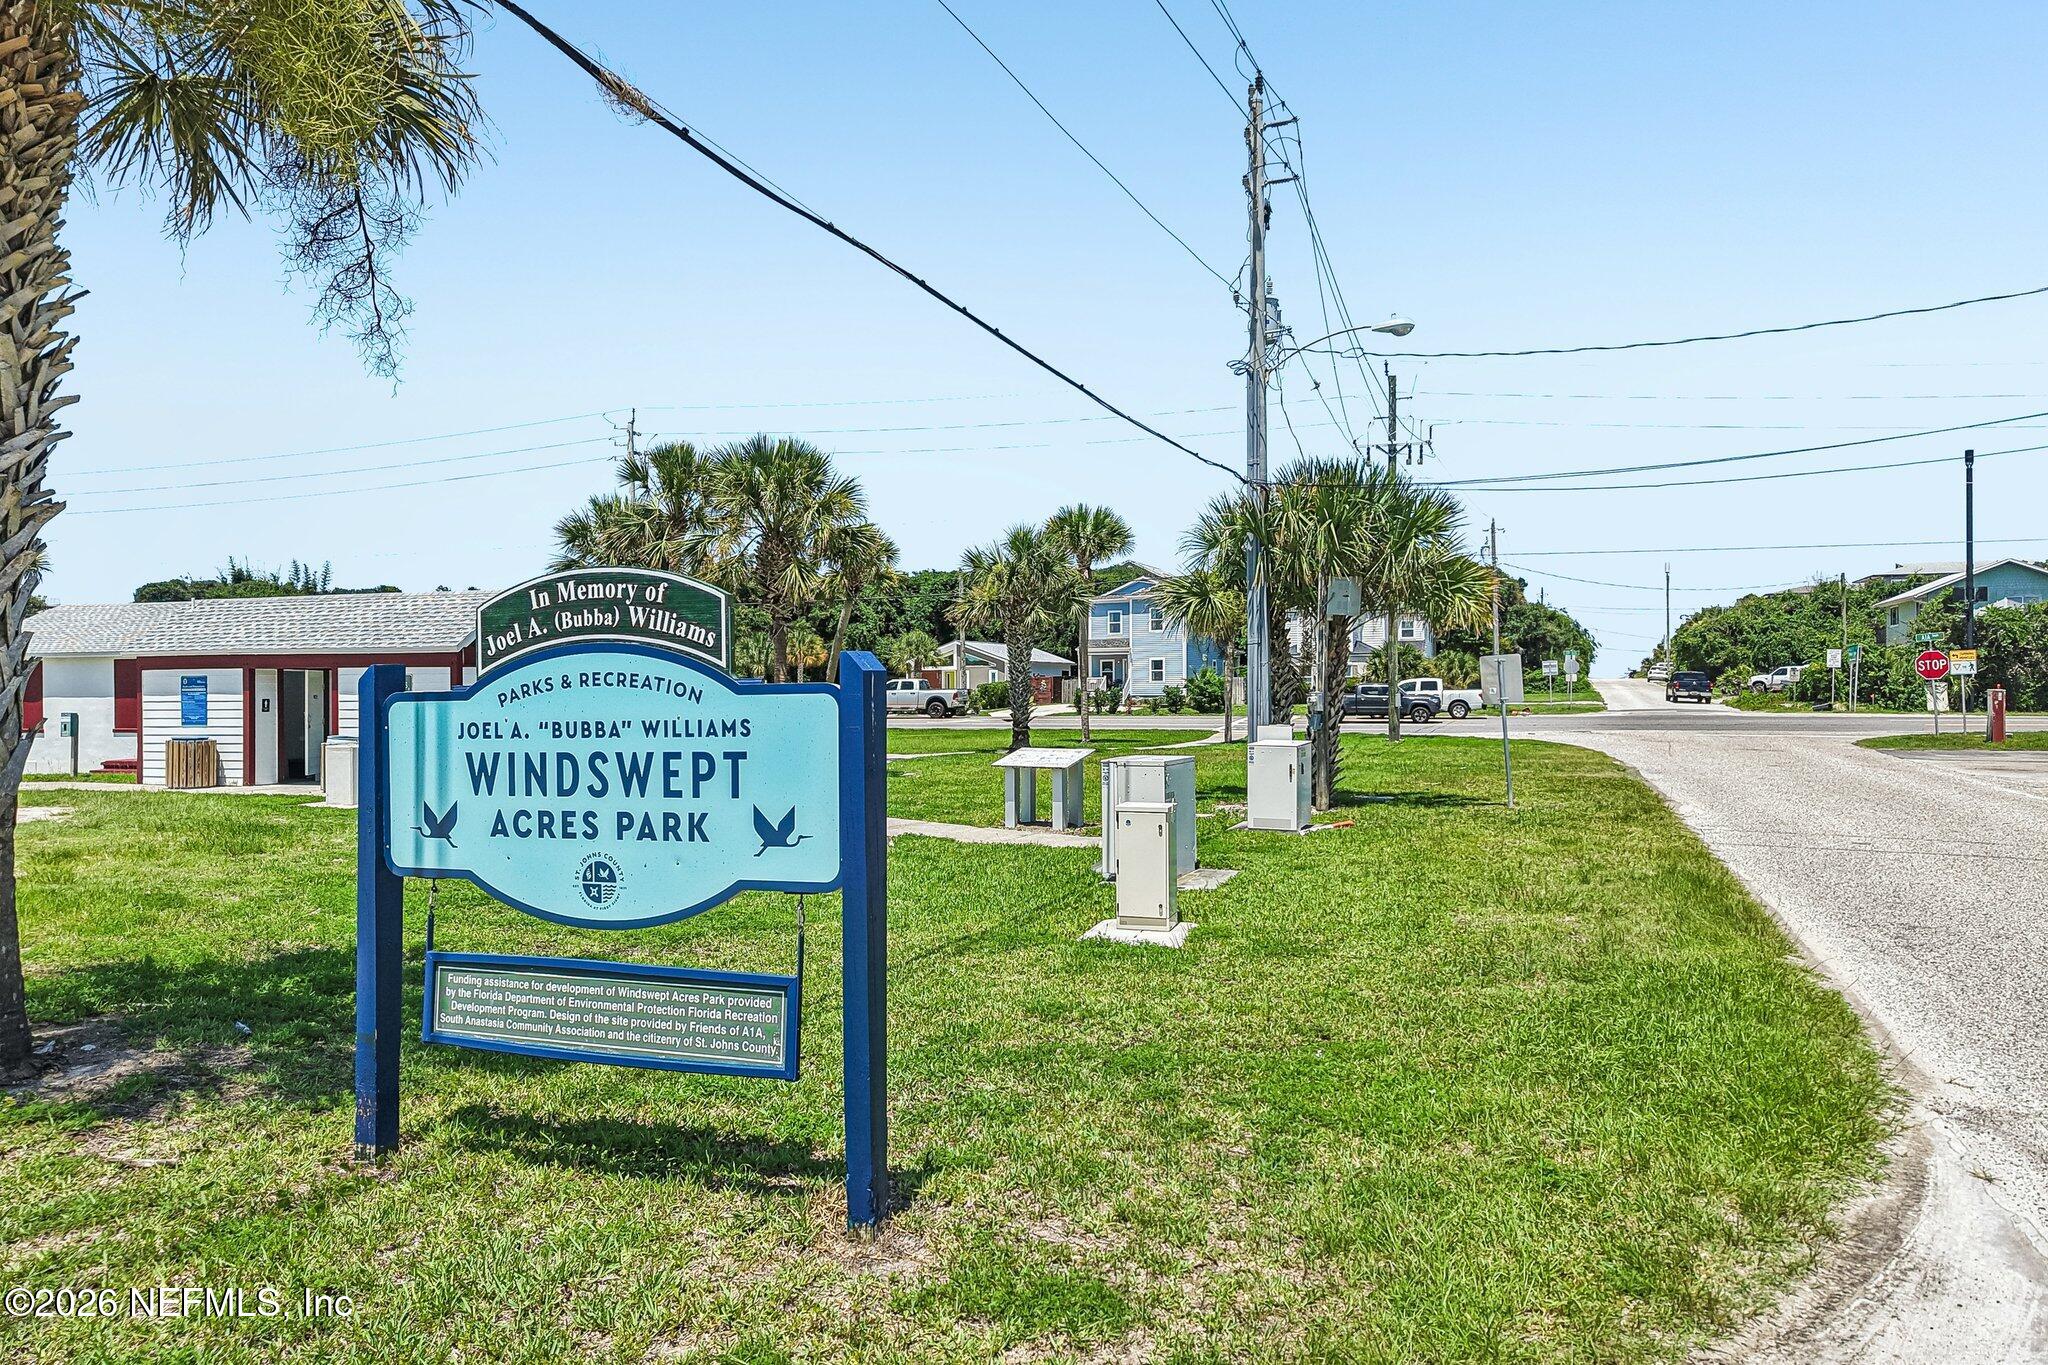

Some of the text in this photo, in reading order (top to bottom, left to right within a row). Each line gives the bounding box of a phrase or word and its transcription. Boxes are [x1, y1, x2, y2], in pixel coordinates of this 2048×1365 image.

[528, 580, 669, 611] In Memory of
[485, 605, 717, 657] Joel A. (Bubba) Williams
[1918, 659, 1947, 671] STOP
[498, 672, 703, 707] PARKS & RECREATION
[458, 718, 751, 739] JOEL A. "BUBBA" WILLIAMS
[465, 751, 748, 798] WINDSWEPT
[490, 809, 710, 842] ACRES PARK
[580, 852, 601, 867] JOHNS
[604, 853, 624, 882] COUNTY
[446, 987, 778, 1023] by the Florida Department of Environmental Protection Florida Recreation
[448, 974, 772, 1009] Funding assistance for development of Windswept Acres Park provided
[440, 1012, 778, 1057] South Anastasia Community Association and the citizenry of St. Johns County.
[451, 1000, 765, 1040] Development Program. Design of the site provided by Friends of A1A,
